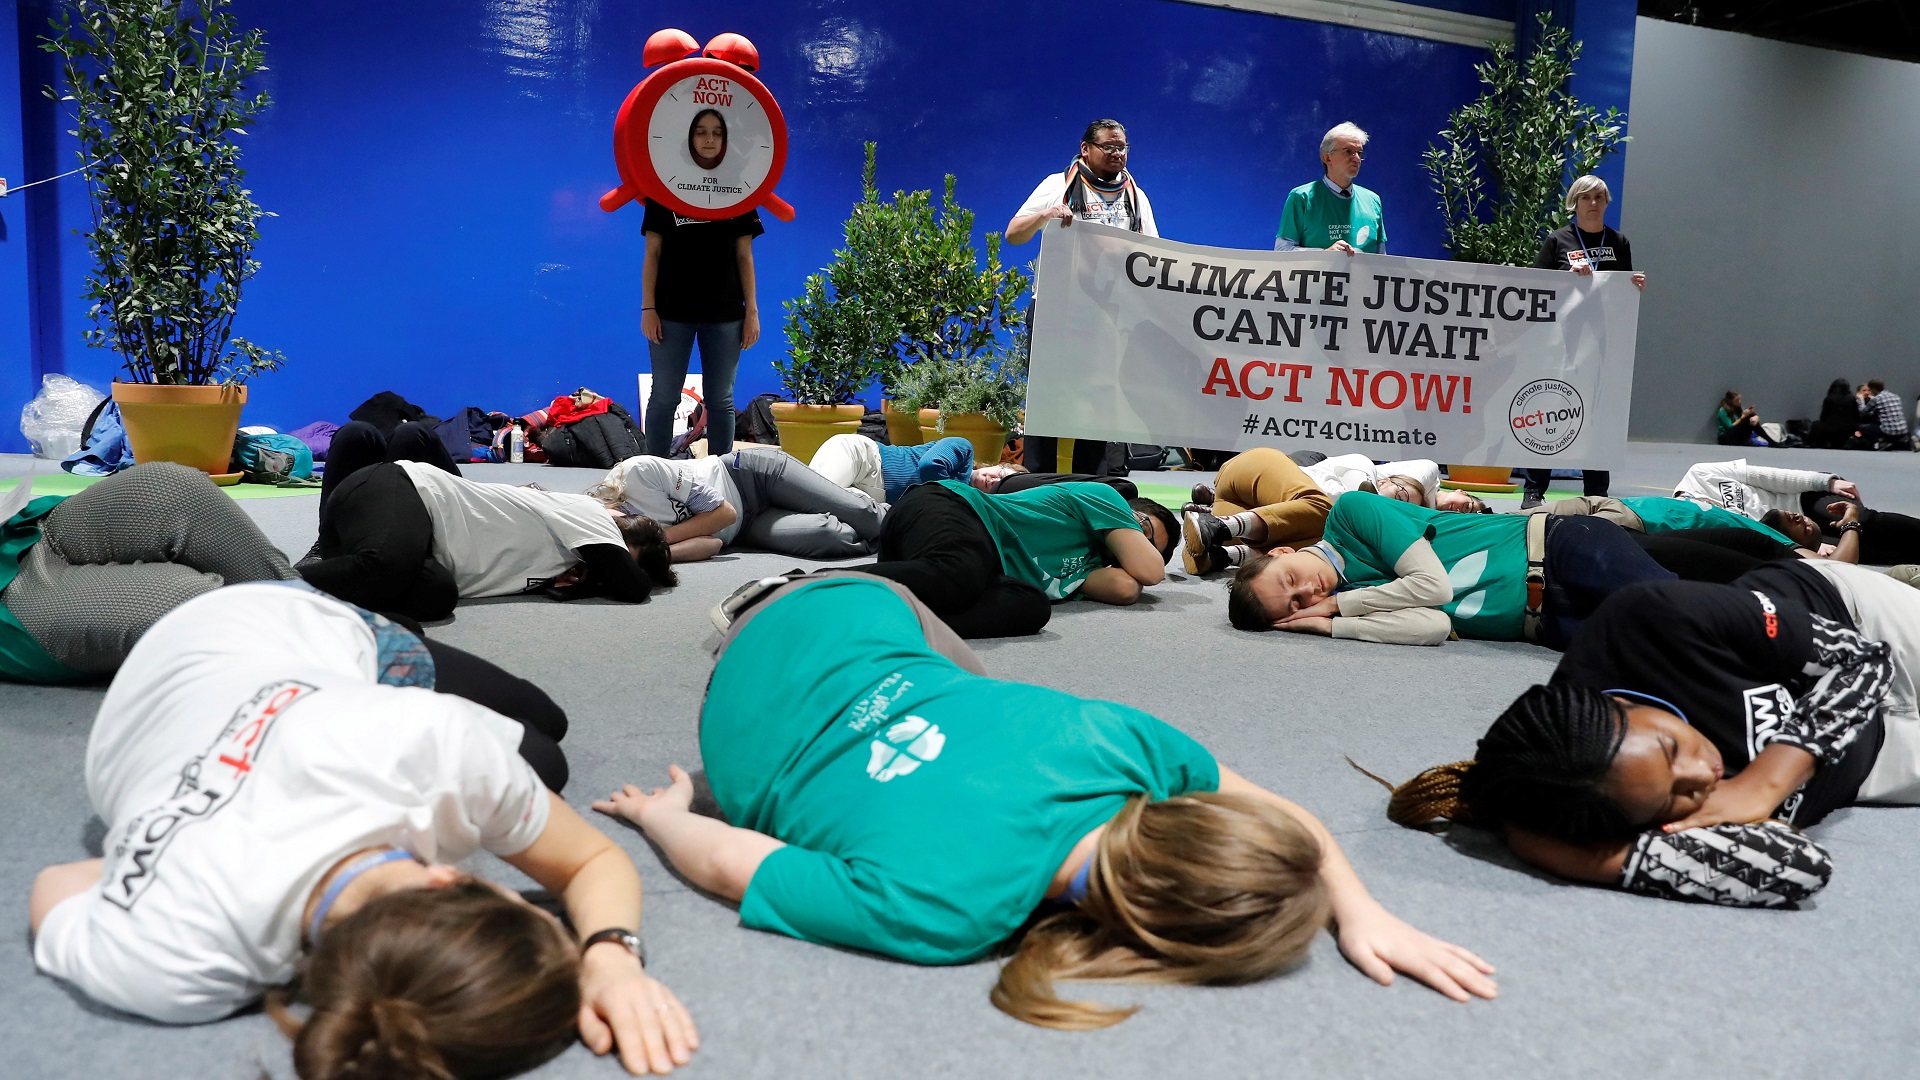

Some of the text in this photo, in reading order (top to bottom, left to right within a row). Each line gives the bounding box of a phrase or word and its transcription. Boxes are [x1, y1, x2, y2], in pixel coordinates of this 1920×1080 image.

[693, 91, 733, 107] NOW
[696, 78, 730, 92] ACT
[677, 183, 742, 194] CLIMATE JUSTICE
[1125, 251, 1557, 323] CLIMATE JUSTICE
[1192, 305, 1488, 361] CAN'T WAIT
[1201, 357, 1472, 414] ACT NOW!
[1517, 382, 1572, 406] climate justice
[1242, 413, 1437, 446] #ACT4Climate
[1524, 430, 1575, 452] climate justice
[1545, 427, 1557, 435] for
[1061, 558, 1070, 577] SALE
[219, 687, 300, 780] act
[1750, 696, 1780, 753] ow
[121, 788, 222, 897] now
